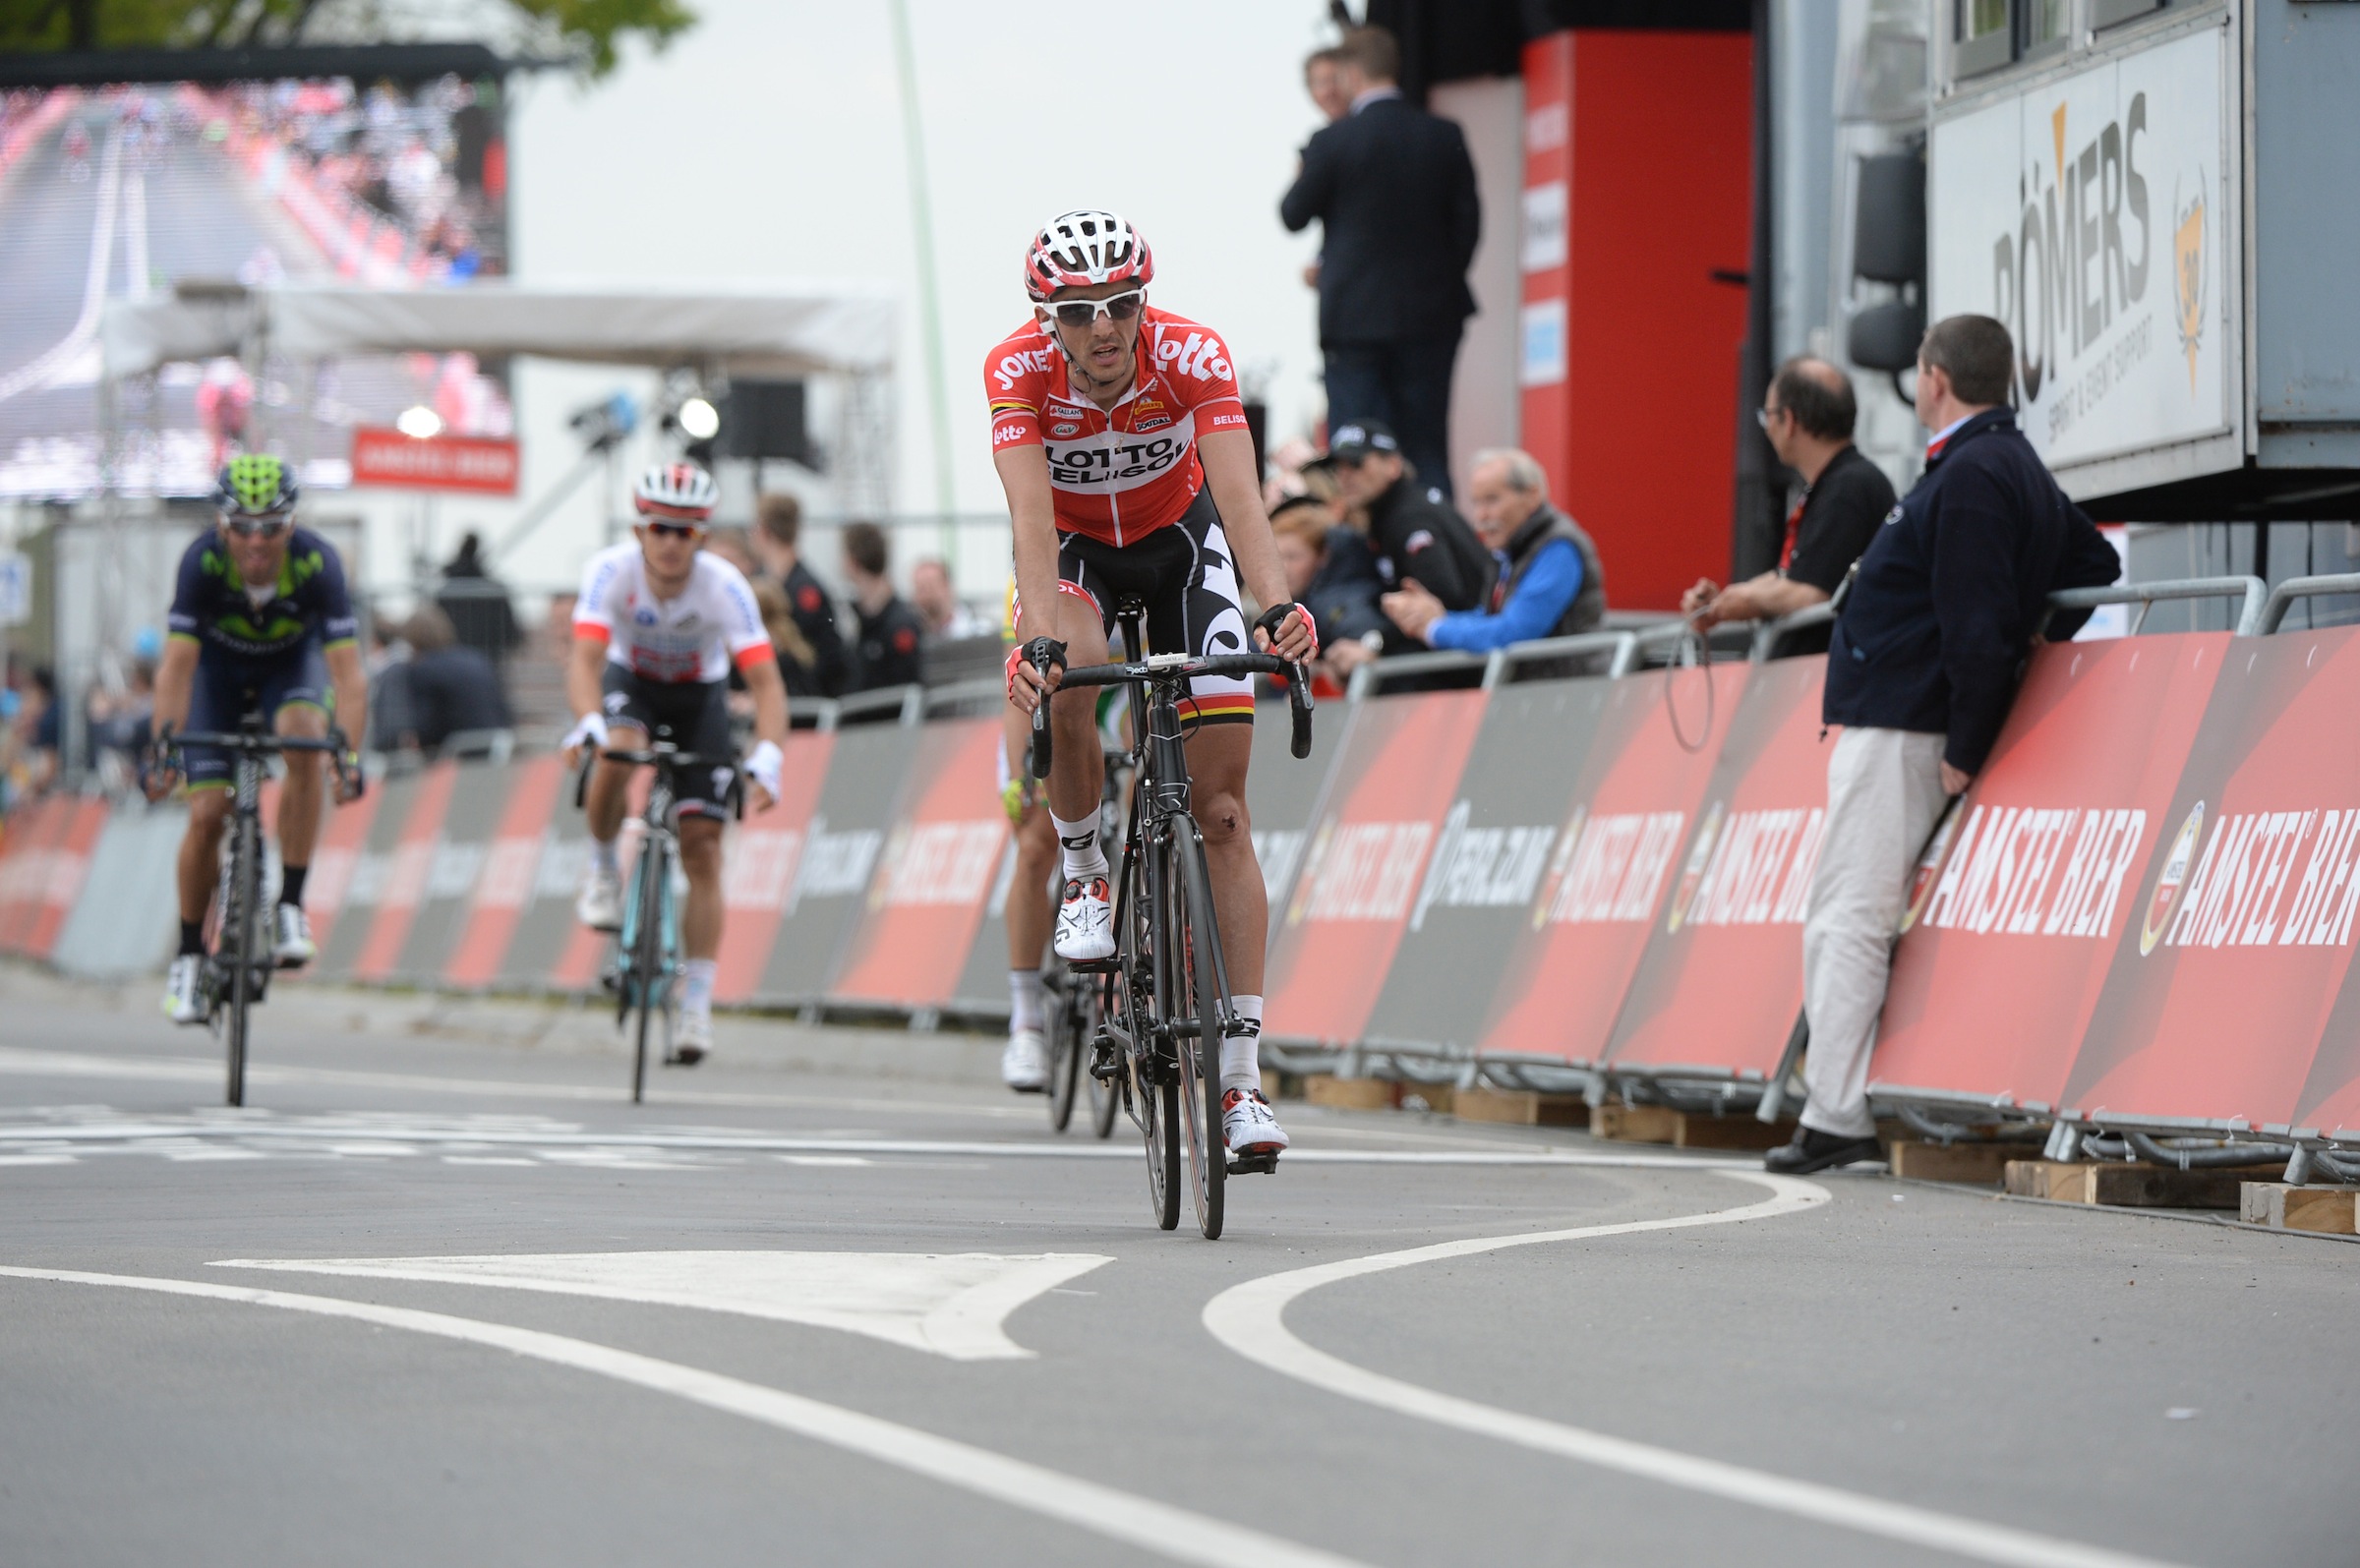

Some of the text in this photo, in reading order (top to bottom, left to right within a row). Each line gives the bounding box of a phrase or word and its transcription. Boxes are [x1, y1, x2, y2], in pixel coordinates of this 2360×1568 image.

[1038, 249, 1063, 278] LAZER
[1137, 417, 1170, 431] SOUDAL
[1213, 414, 1247, 426] BELISO
[1045, 437, 1172, 469] LOTTO
[1048, 438, 1190, 484] ELISOL
[1685, 807, 1806, 925] AMSTEL
[1922, 804, 2147, 938] AMSTEL BIER
[2164, 810, 2312, 949] AMSTEL
